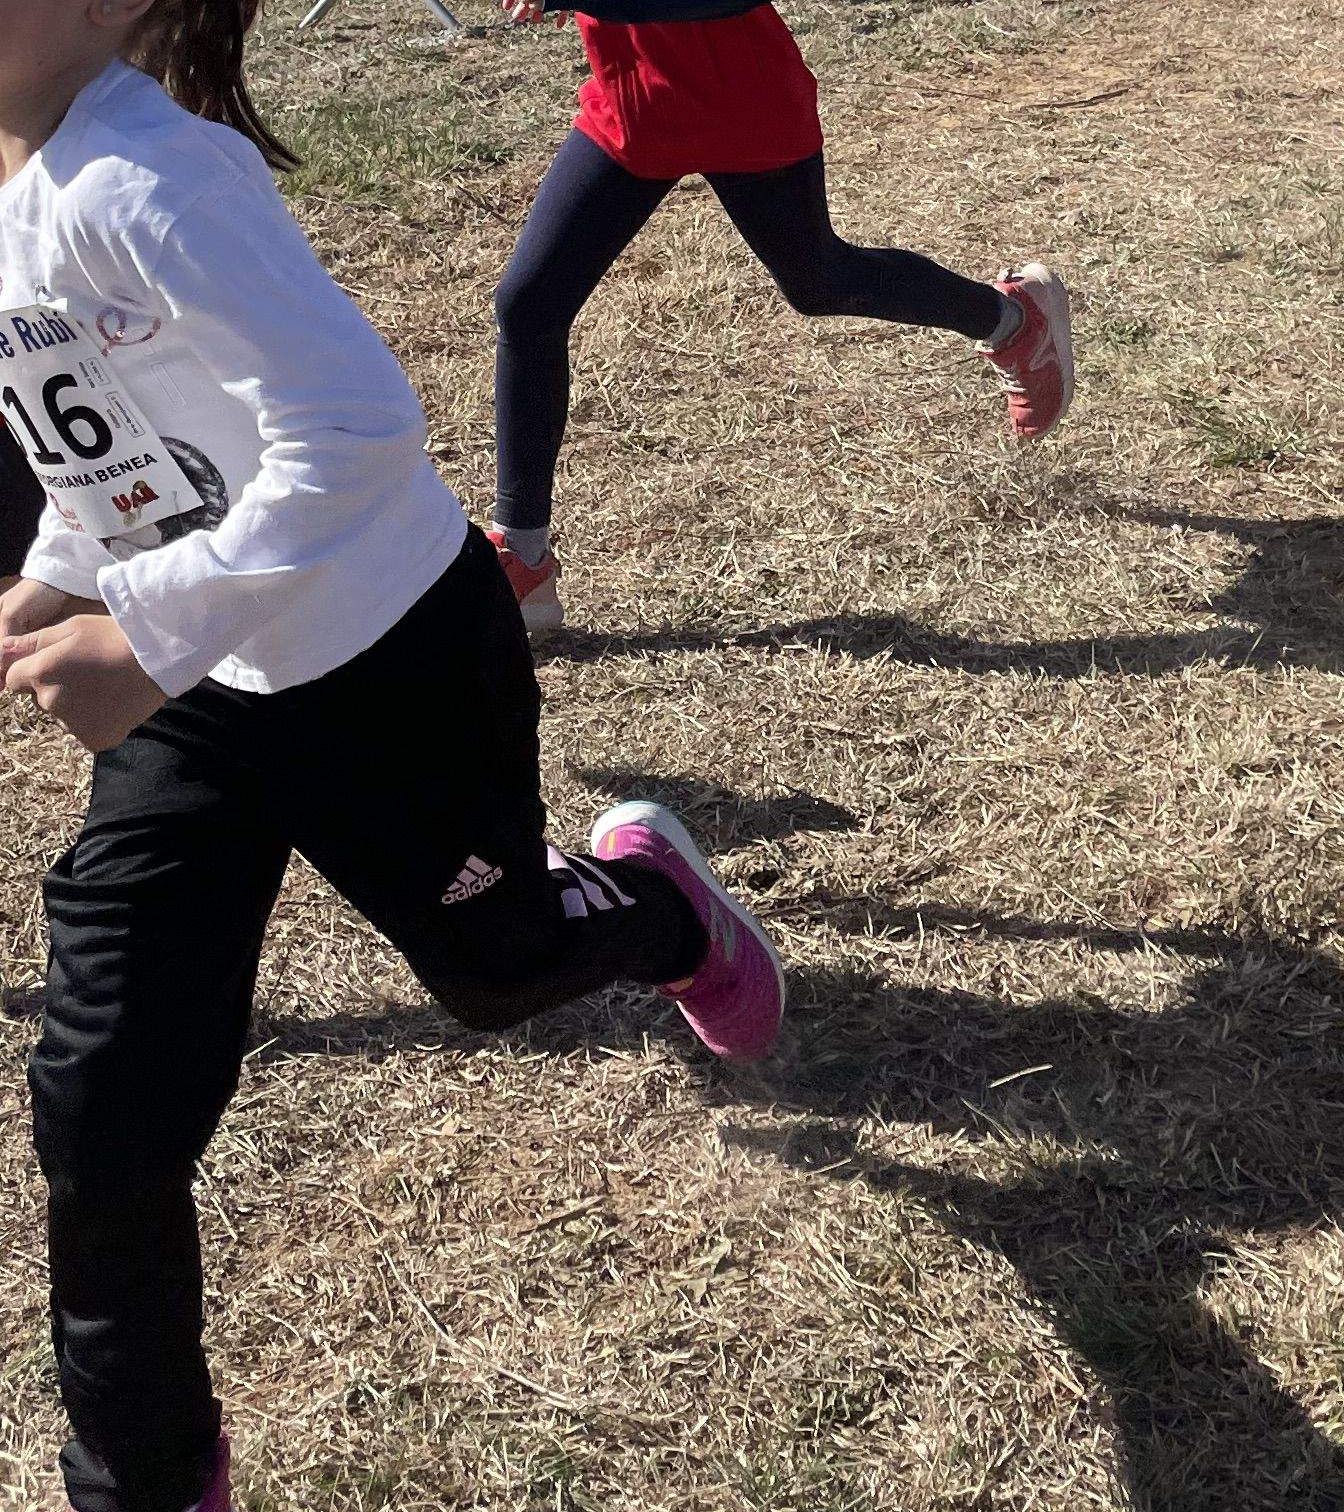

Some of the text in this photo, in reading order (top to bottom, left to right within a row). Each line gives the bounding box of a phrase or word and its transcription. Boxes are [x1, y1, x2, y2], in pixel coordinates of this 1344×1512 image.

[1, 372, 115, 465] 16
[94, 452, 158, 483] BENEA
[441, 865, 503, 905] adidas
